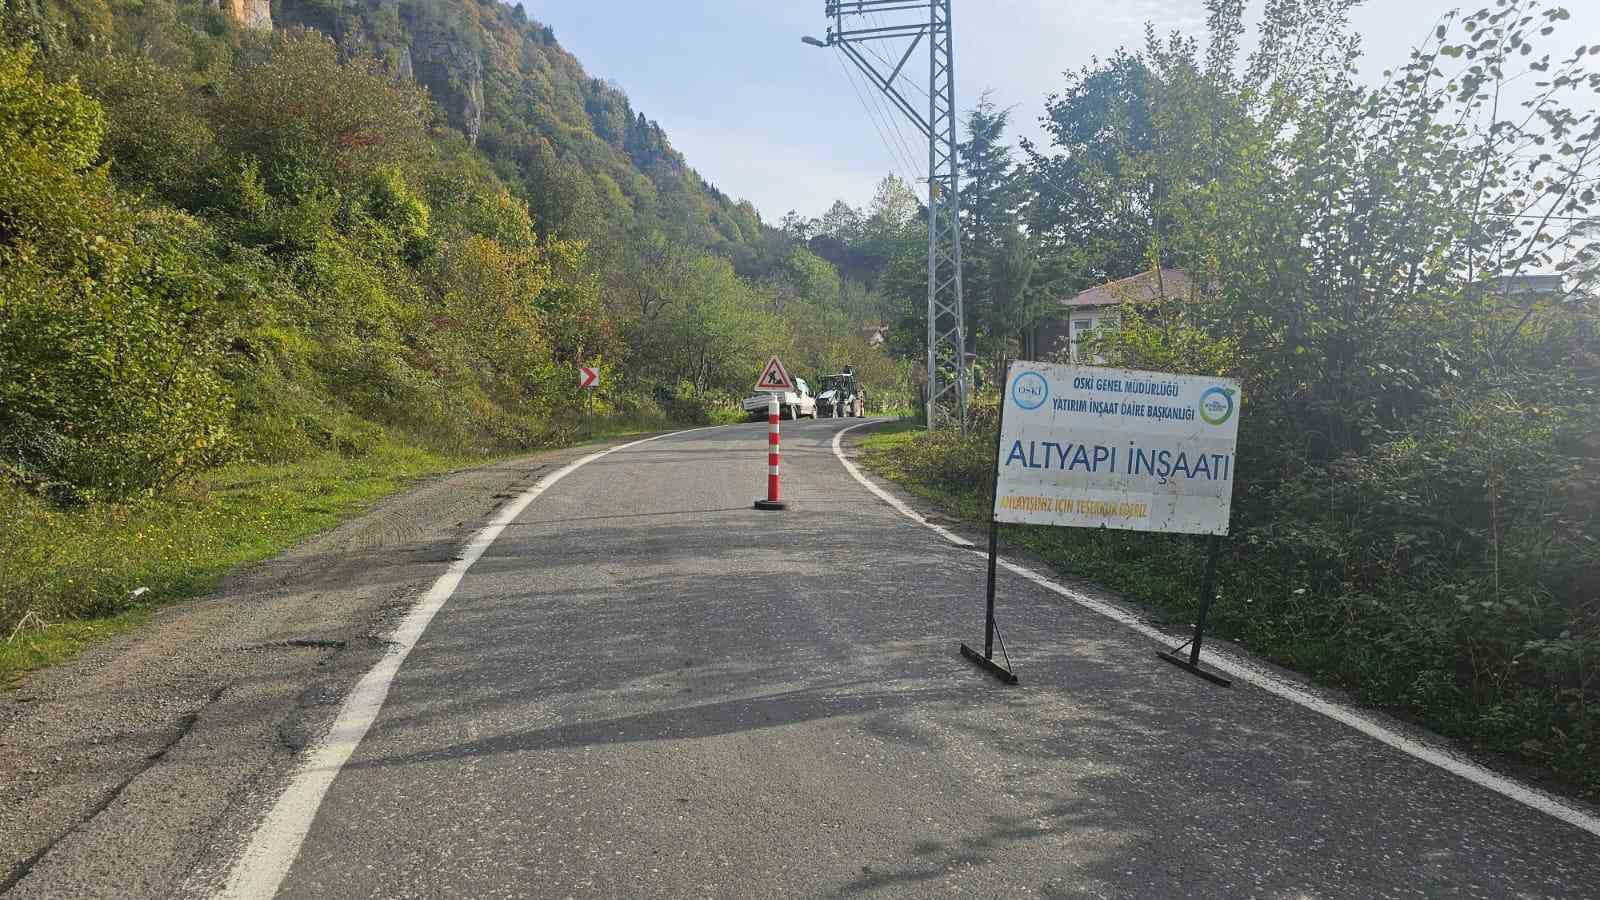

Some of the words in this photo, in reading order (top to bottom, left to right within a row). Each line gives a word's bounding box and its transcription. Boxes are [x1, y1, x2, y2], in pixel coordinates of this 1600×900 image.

[1073, 376, 1095, 390] OSKİ
[1096, 378, 1123, 392] GENEL
[1124, 380, 1179, 397] MÜDÜRLÜĞÜ
[1053, 398, 1088, 412] YATIRIM
[1089, 398, 1119, 416] İNŞAAT
[1121, 402, 1146, 417] DAİRE
[1147, 405, 1195, 421] BAŞKANLIĞI
[1005, 440, 1116, 473] ALTYAPI
[1127, 441, 1229, 485] İNŞAATI
